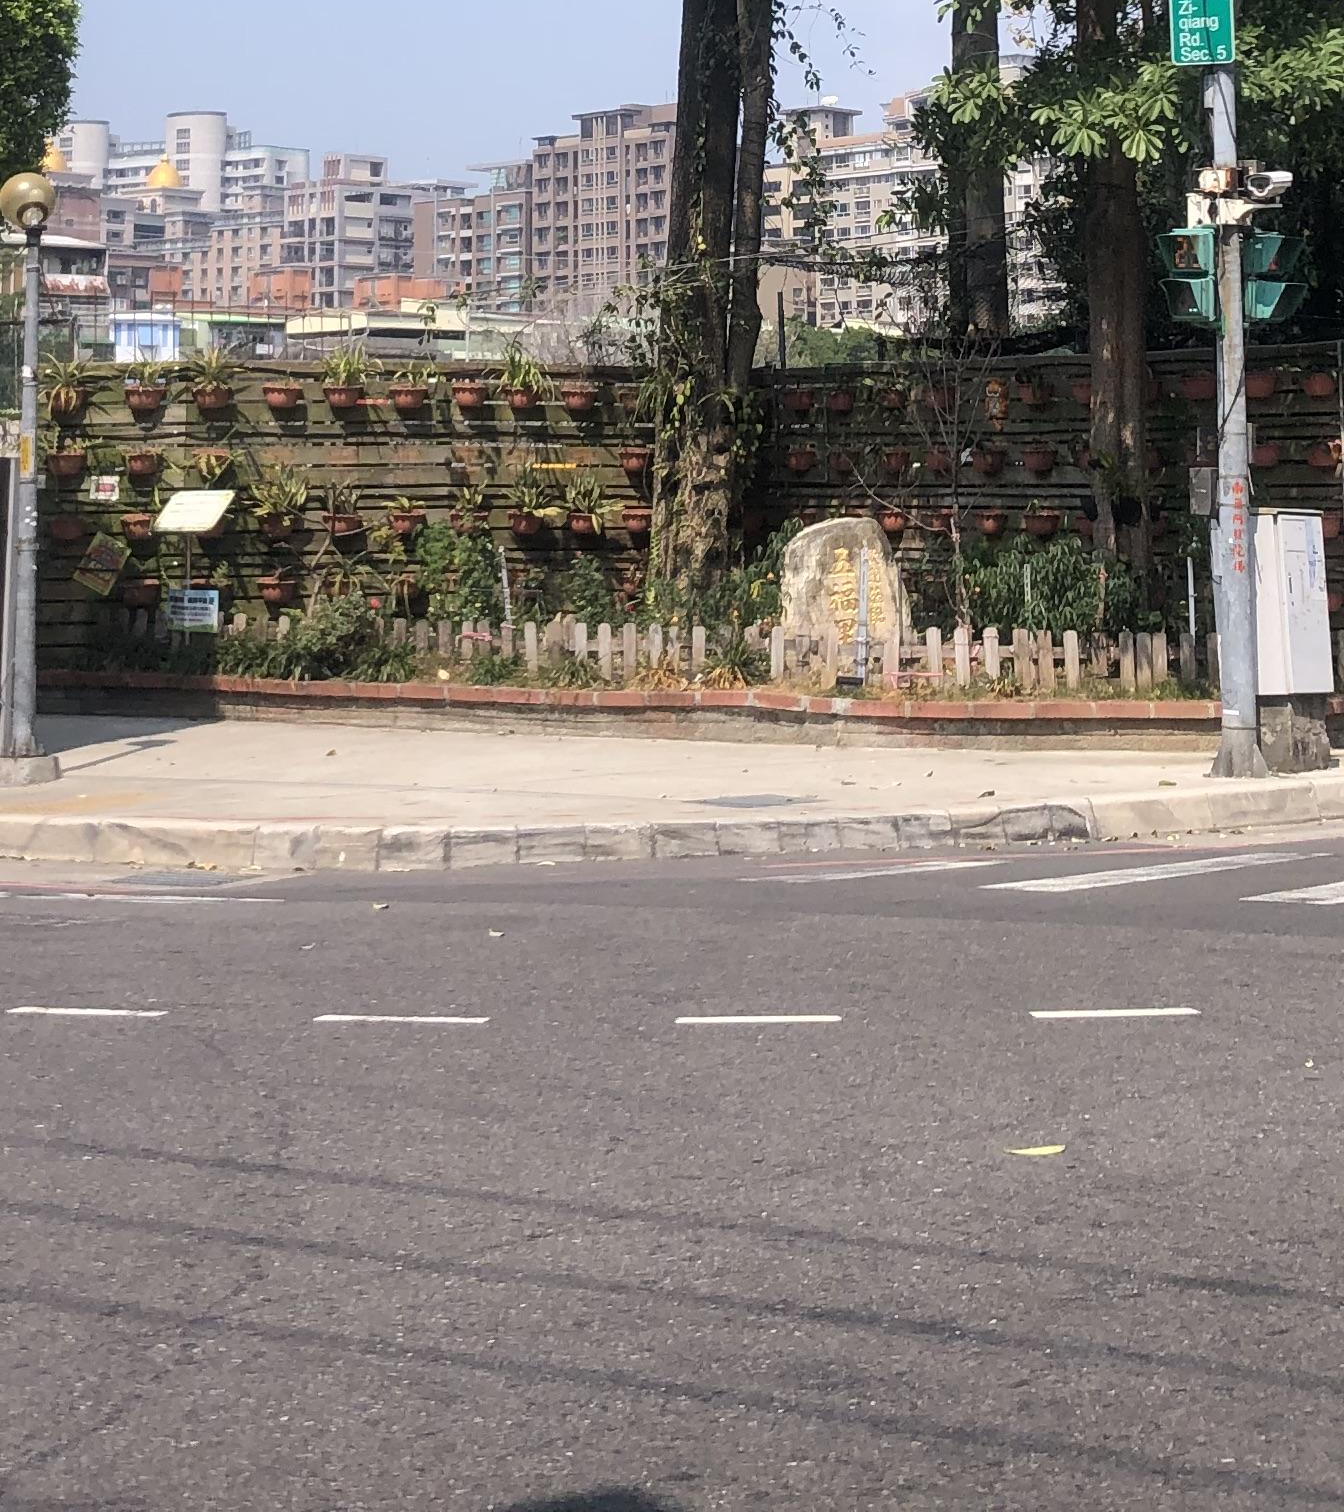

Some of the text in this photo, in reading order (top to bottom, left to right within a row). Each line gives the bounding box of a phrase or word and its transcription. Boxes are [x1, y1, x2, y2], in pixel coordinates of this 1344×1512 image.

[1178, 0, 1198, 15] Zi-
[1178, 14, 1219, 33] qiang
[1179, 32, 1204, 47] Rd.
[1180, 44, 1227, 62] Sec. 5
